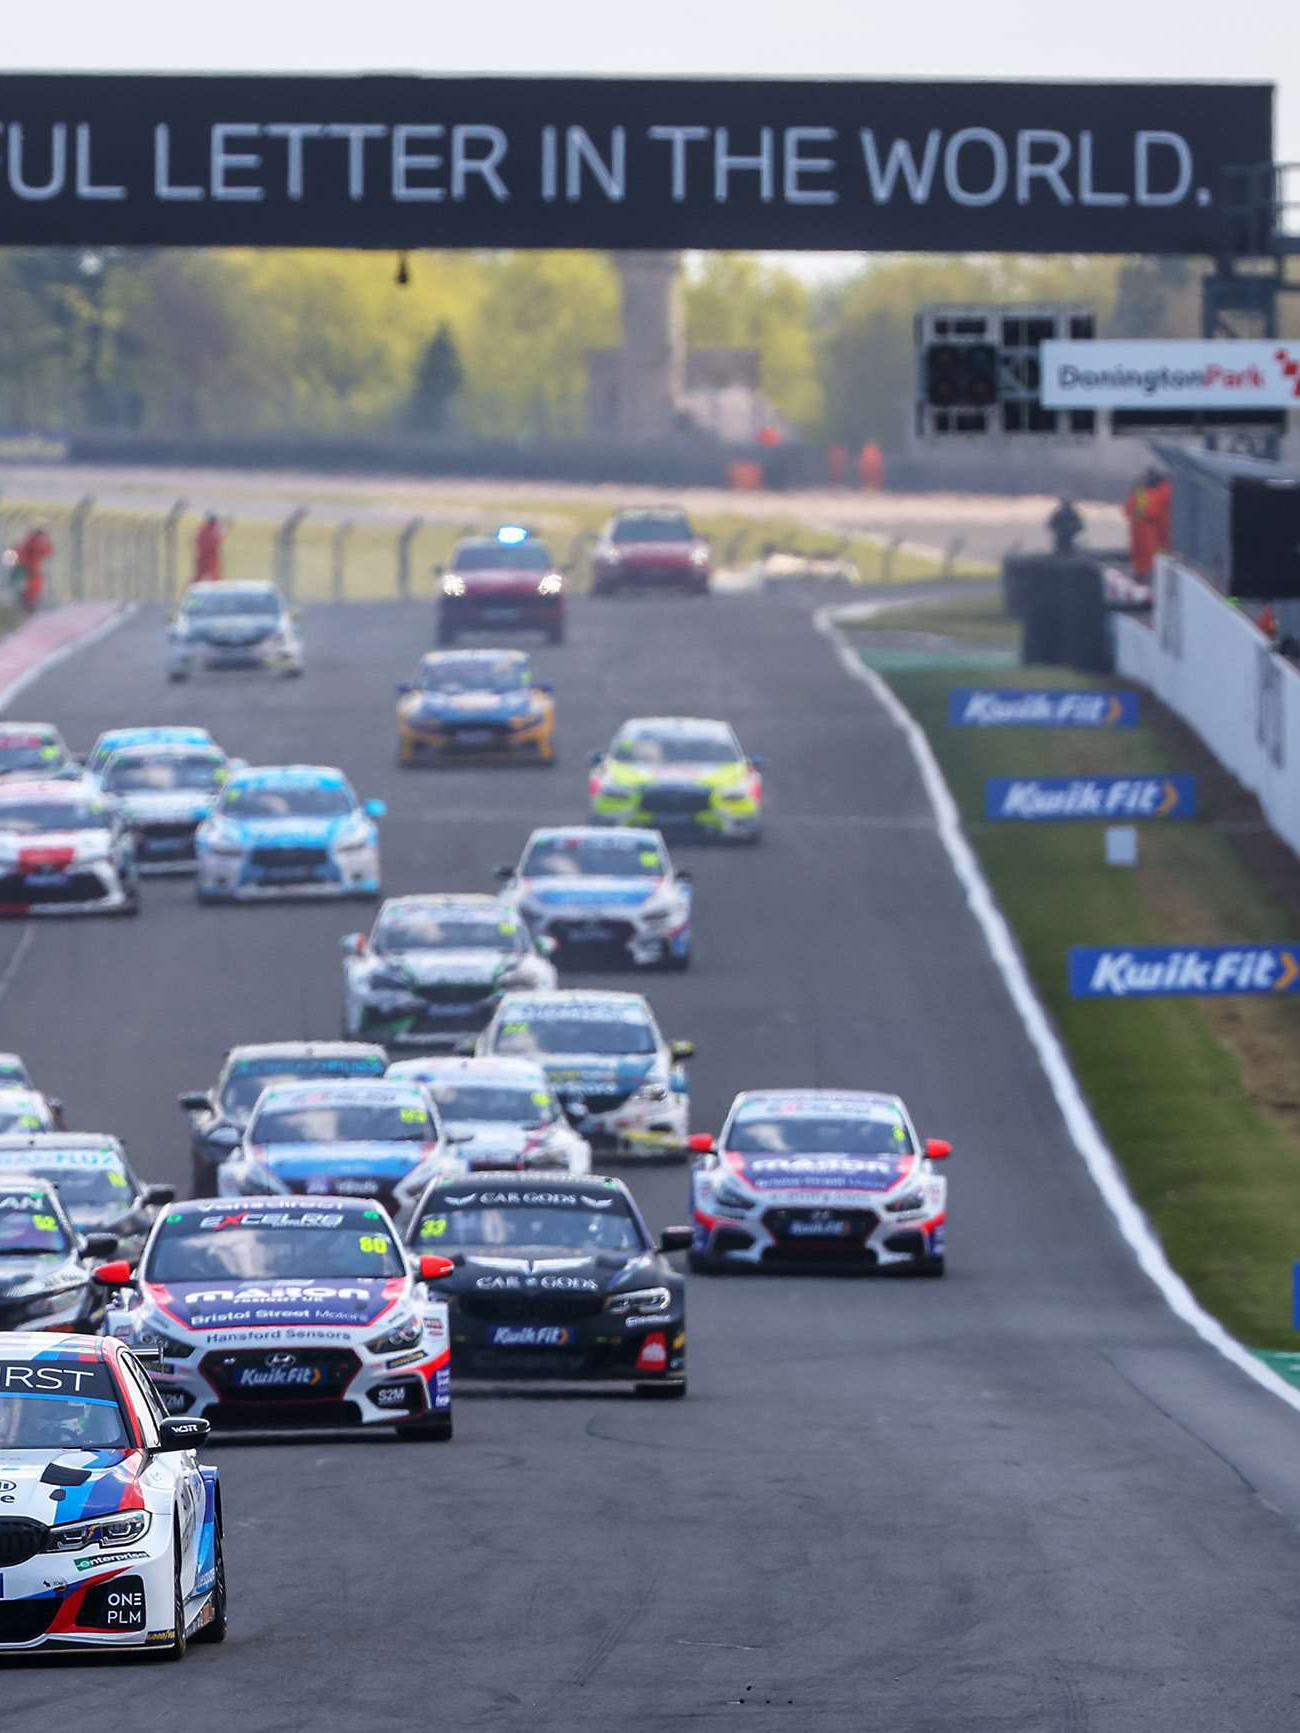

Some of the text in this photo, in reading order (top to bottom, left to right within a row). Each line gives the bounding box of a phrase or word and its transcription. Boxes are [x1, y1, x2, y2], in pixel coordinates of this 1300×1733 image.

[155, 121, 508, 202] LETTER
[541, 124, 626, 201] IN
[650, 125, 839, 203] THE
[861, 127, 1213, 207] WORLD.
[480, 1191, 577, 1204] CAR GODS
[420, 1218, 448, 1238] 33
[476, 1276, 599, 1290] CAR GODS
[190, 1308, 369, 1327] Bristol Street Motors
[206, 1328, 352, 1344] Hansford Sensors
[171, 1424, 199, 1433] WSR
[107, 1592, 142, 1607] ONE
[107, 1609, 142, 1625] PLM
